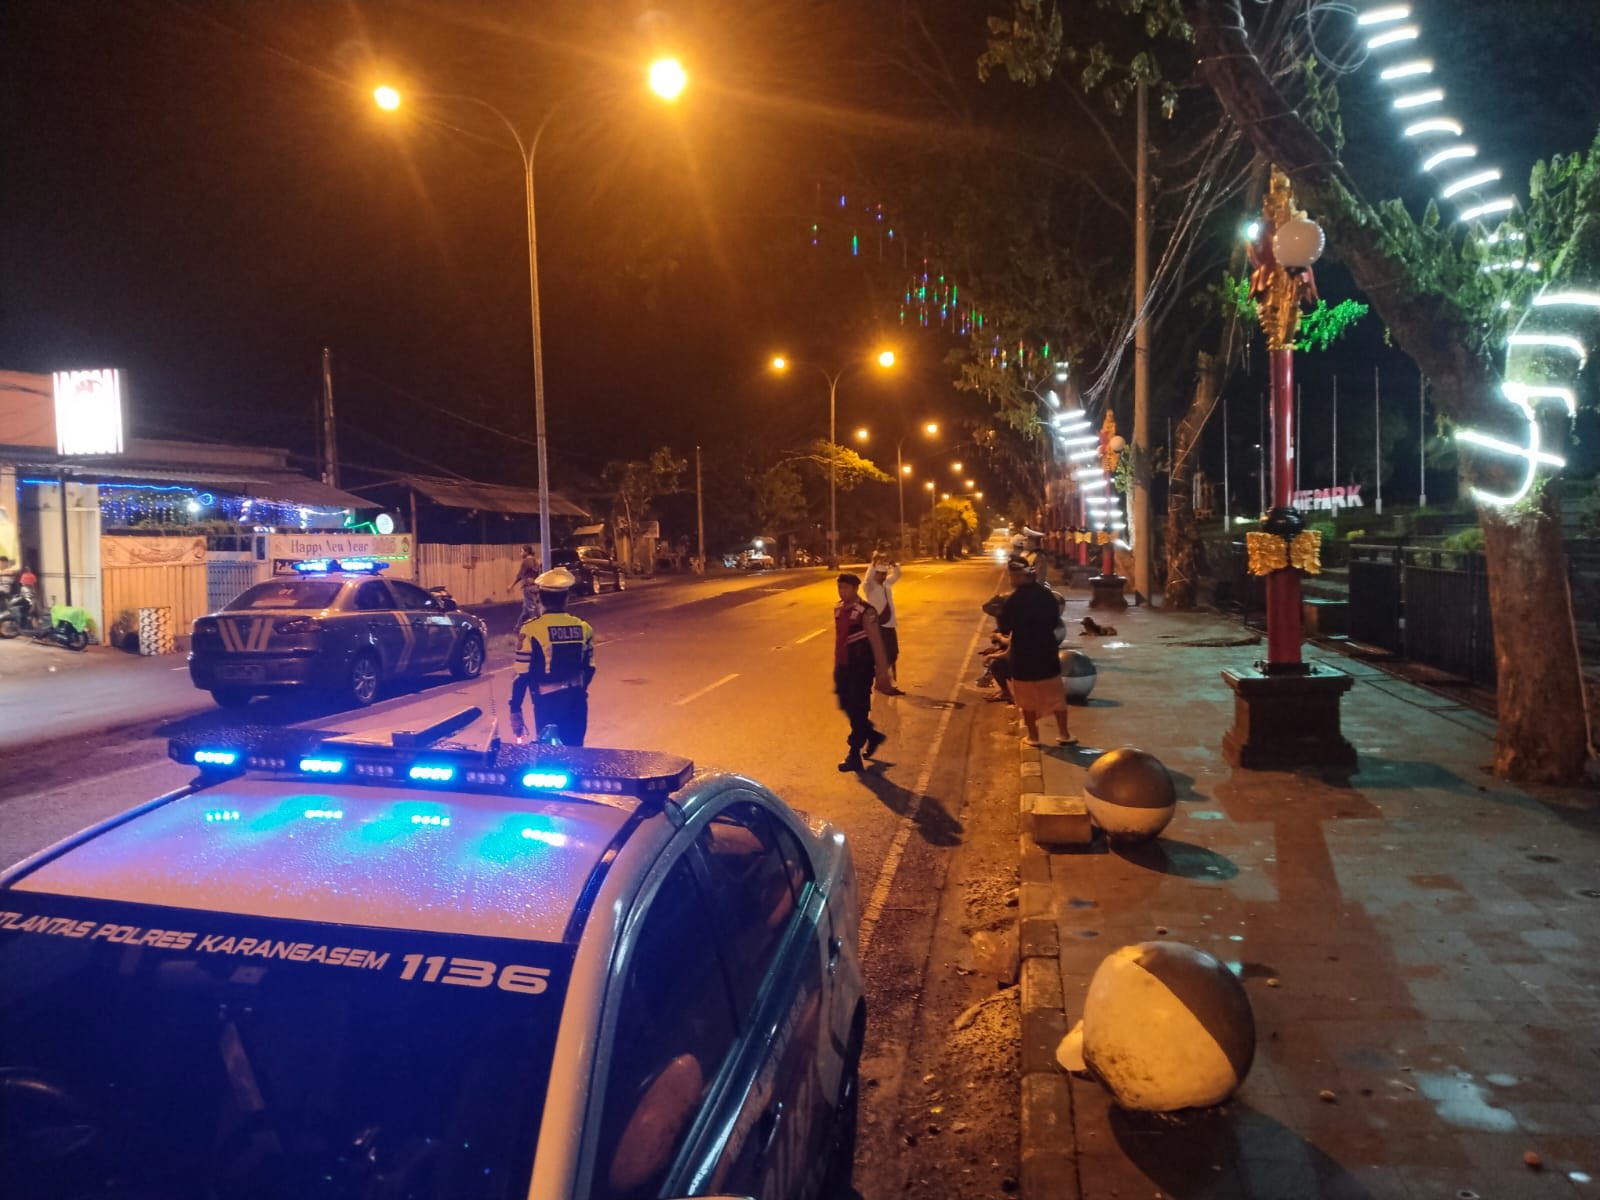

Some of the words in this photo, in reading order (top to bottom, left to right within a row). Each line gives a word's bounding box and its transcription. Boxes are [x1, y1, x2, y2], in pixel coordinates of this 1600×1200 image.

[291, 540, 322, 555] Happy
[91, 924, 197, 950] POLRES
[196, 934, 391, 970] KARANGASEM
[399, 953, 551, 995] 1136
